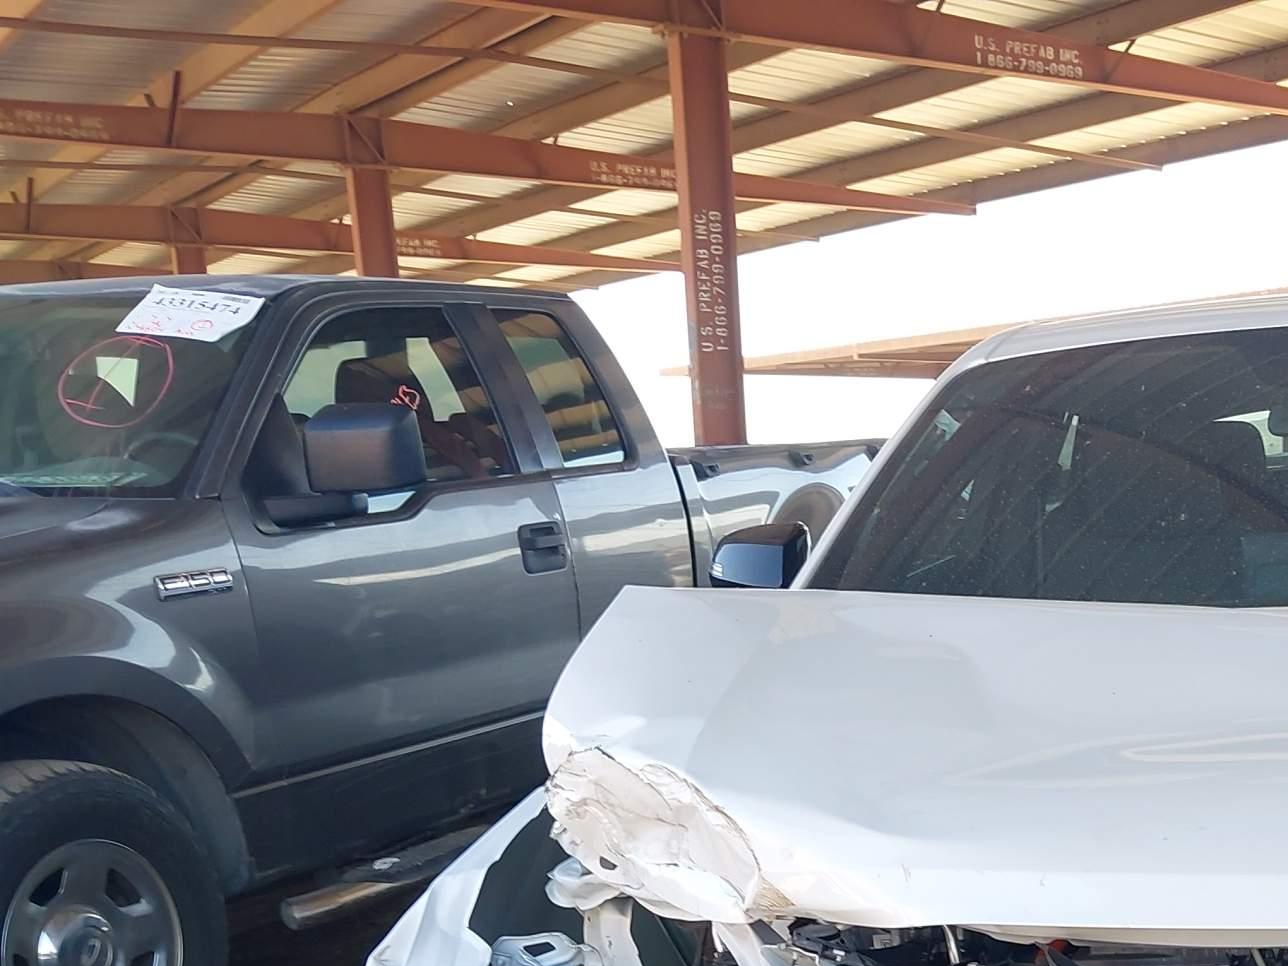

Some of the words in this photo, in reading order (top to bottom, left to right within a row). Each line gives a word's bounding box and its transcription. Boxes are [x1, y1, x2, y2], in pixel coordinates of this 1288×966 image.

[974, 34, 1000, 51] U.S.
[1005, 40, 1055, 60] PREFAB
[1059, 48, 1084, 64] INC.
[694, 208, 709, 240] INC.
[697, 248, 713, 312] PREFAB
[153, 296, 241, 315] 43315474
